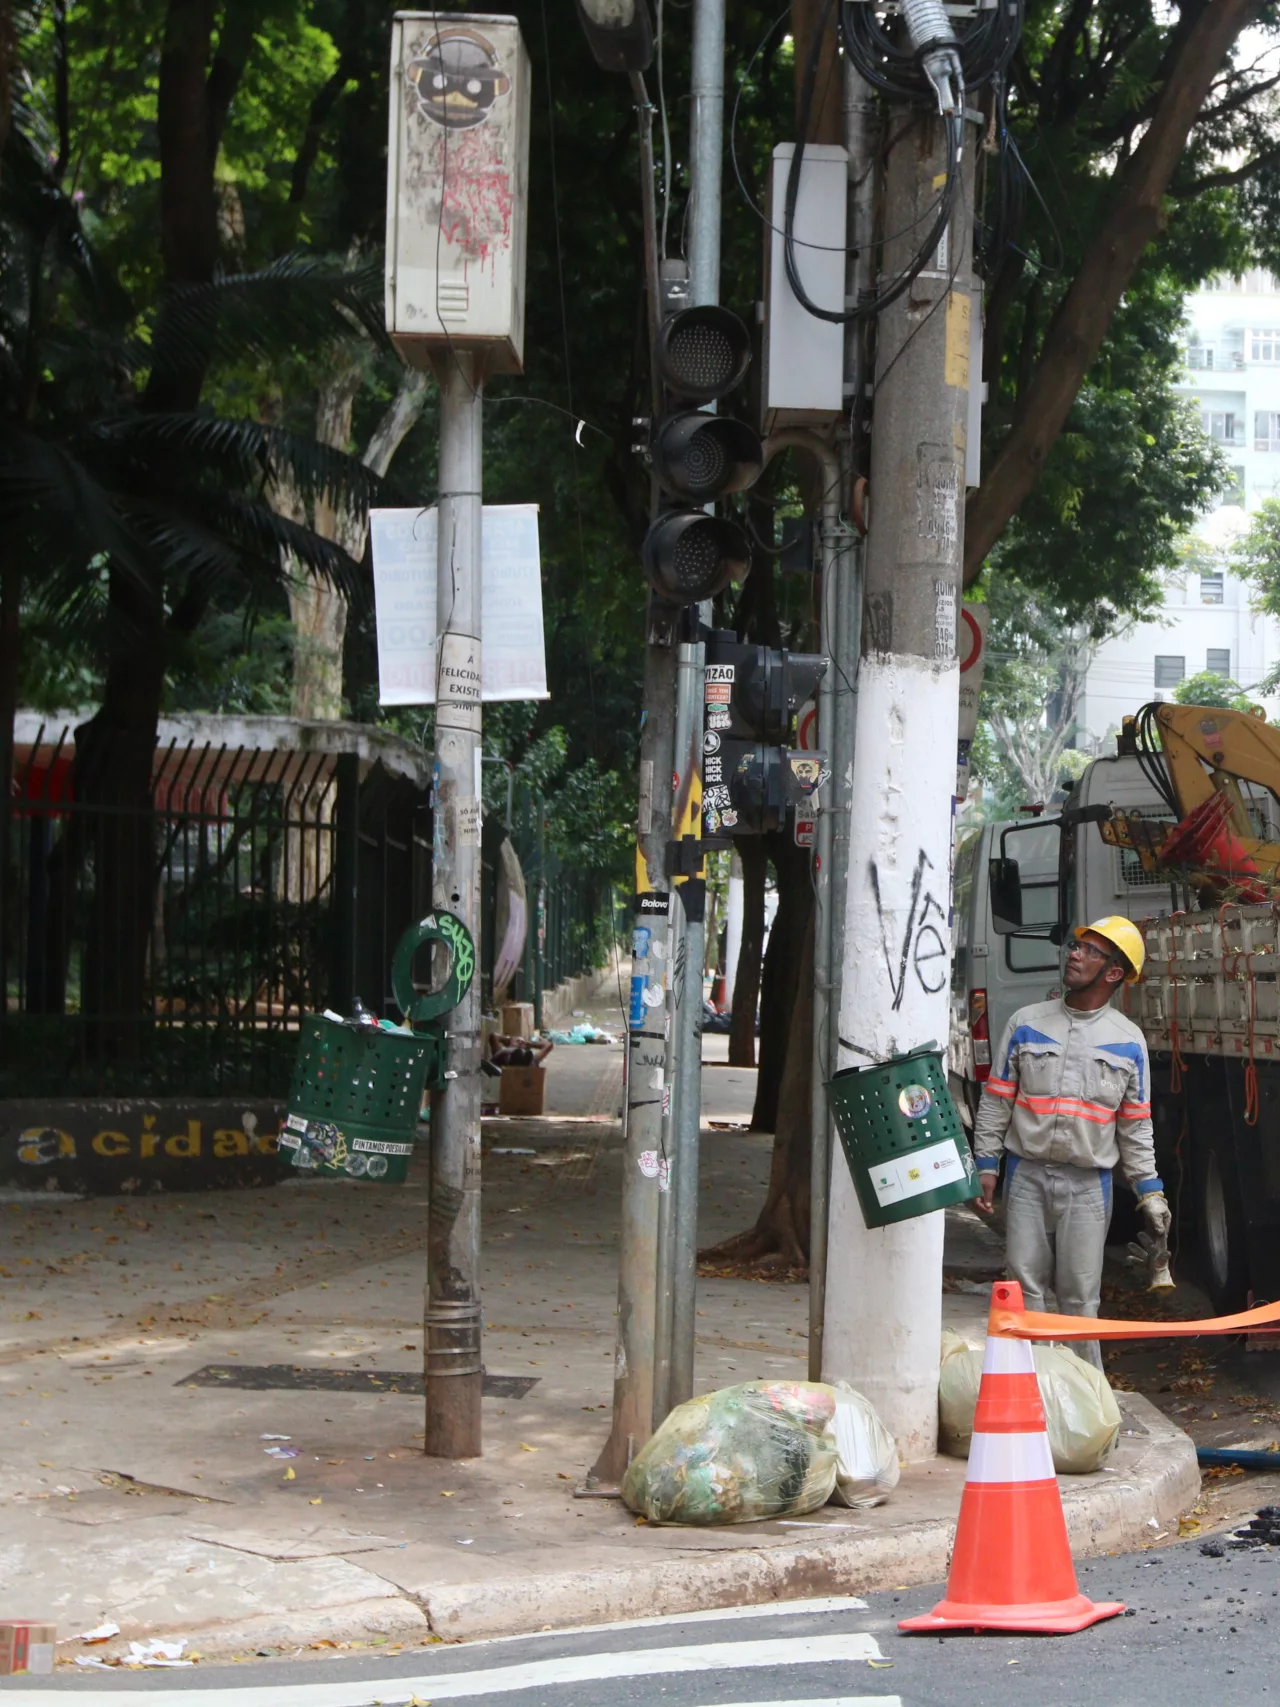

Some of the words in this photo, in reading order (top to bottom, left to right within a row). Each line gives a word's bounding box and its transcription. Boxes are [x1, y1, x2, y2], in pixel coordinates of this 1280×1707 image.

[467, 655, 474, 664] A
[449, 684, 480, 698] EXISTE
[705, 757, 722, 765] NICK
[705, 765, 722, 774] NICK
[705, 774, 722, 782] NICK
[354, 1139, 385, 1152] PINTAMOS
